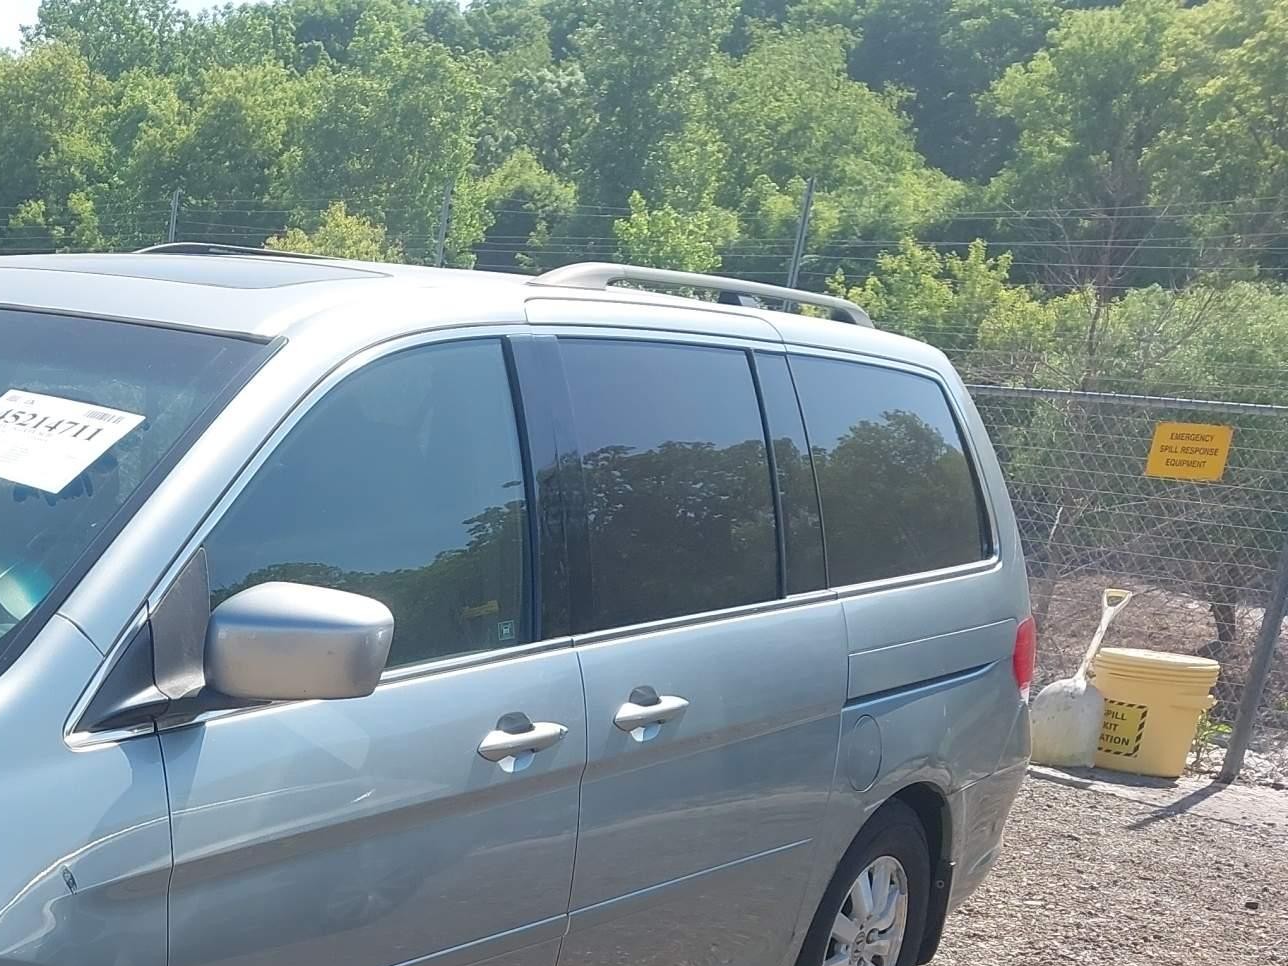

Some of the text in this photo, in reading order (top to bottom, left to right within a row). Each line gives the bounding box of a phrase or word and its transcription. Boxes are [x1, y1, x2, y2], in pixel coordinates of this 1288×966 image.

[1170, 432, 1214, 442] EMERGENCY
[1160, 444, 1220, 457] SPILL RESPONSE
[1165, 458, 1207, 468] EQUIPMENT
